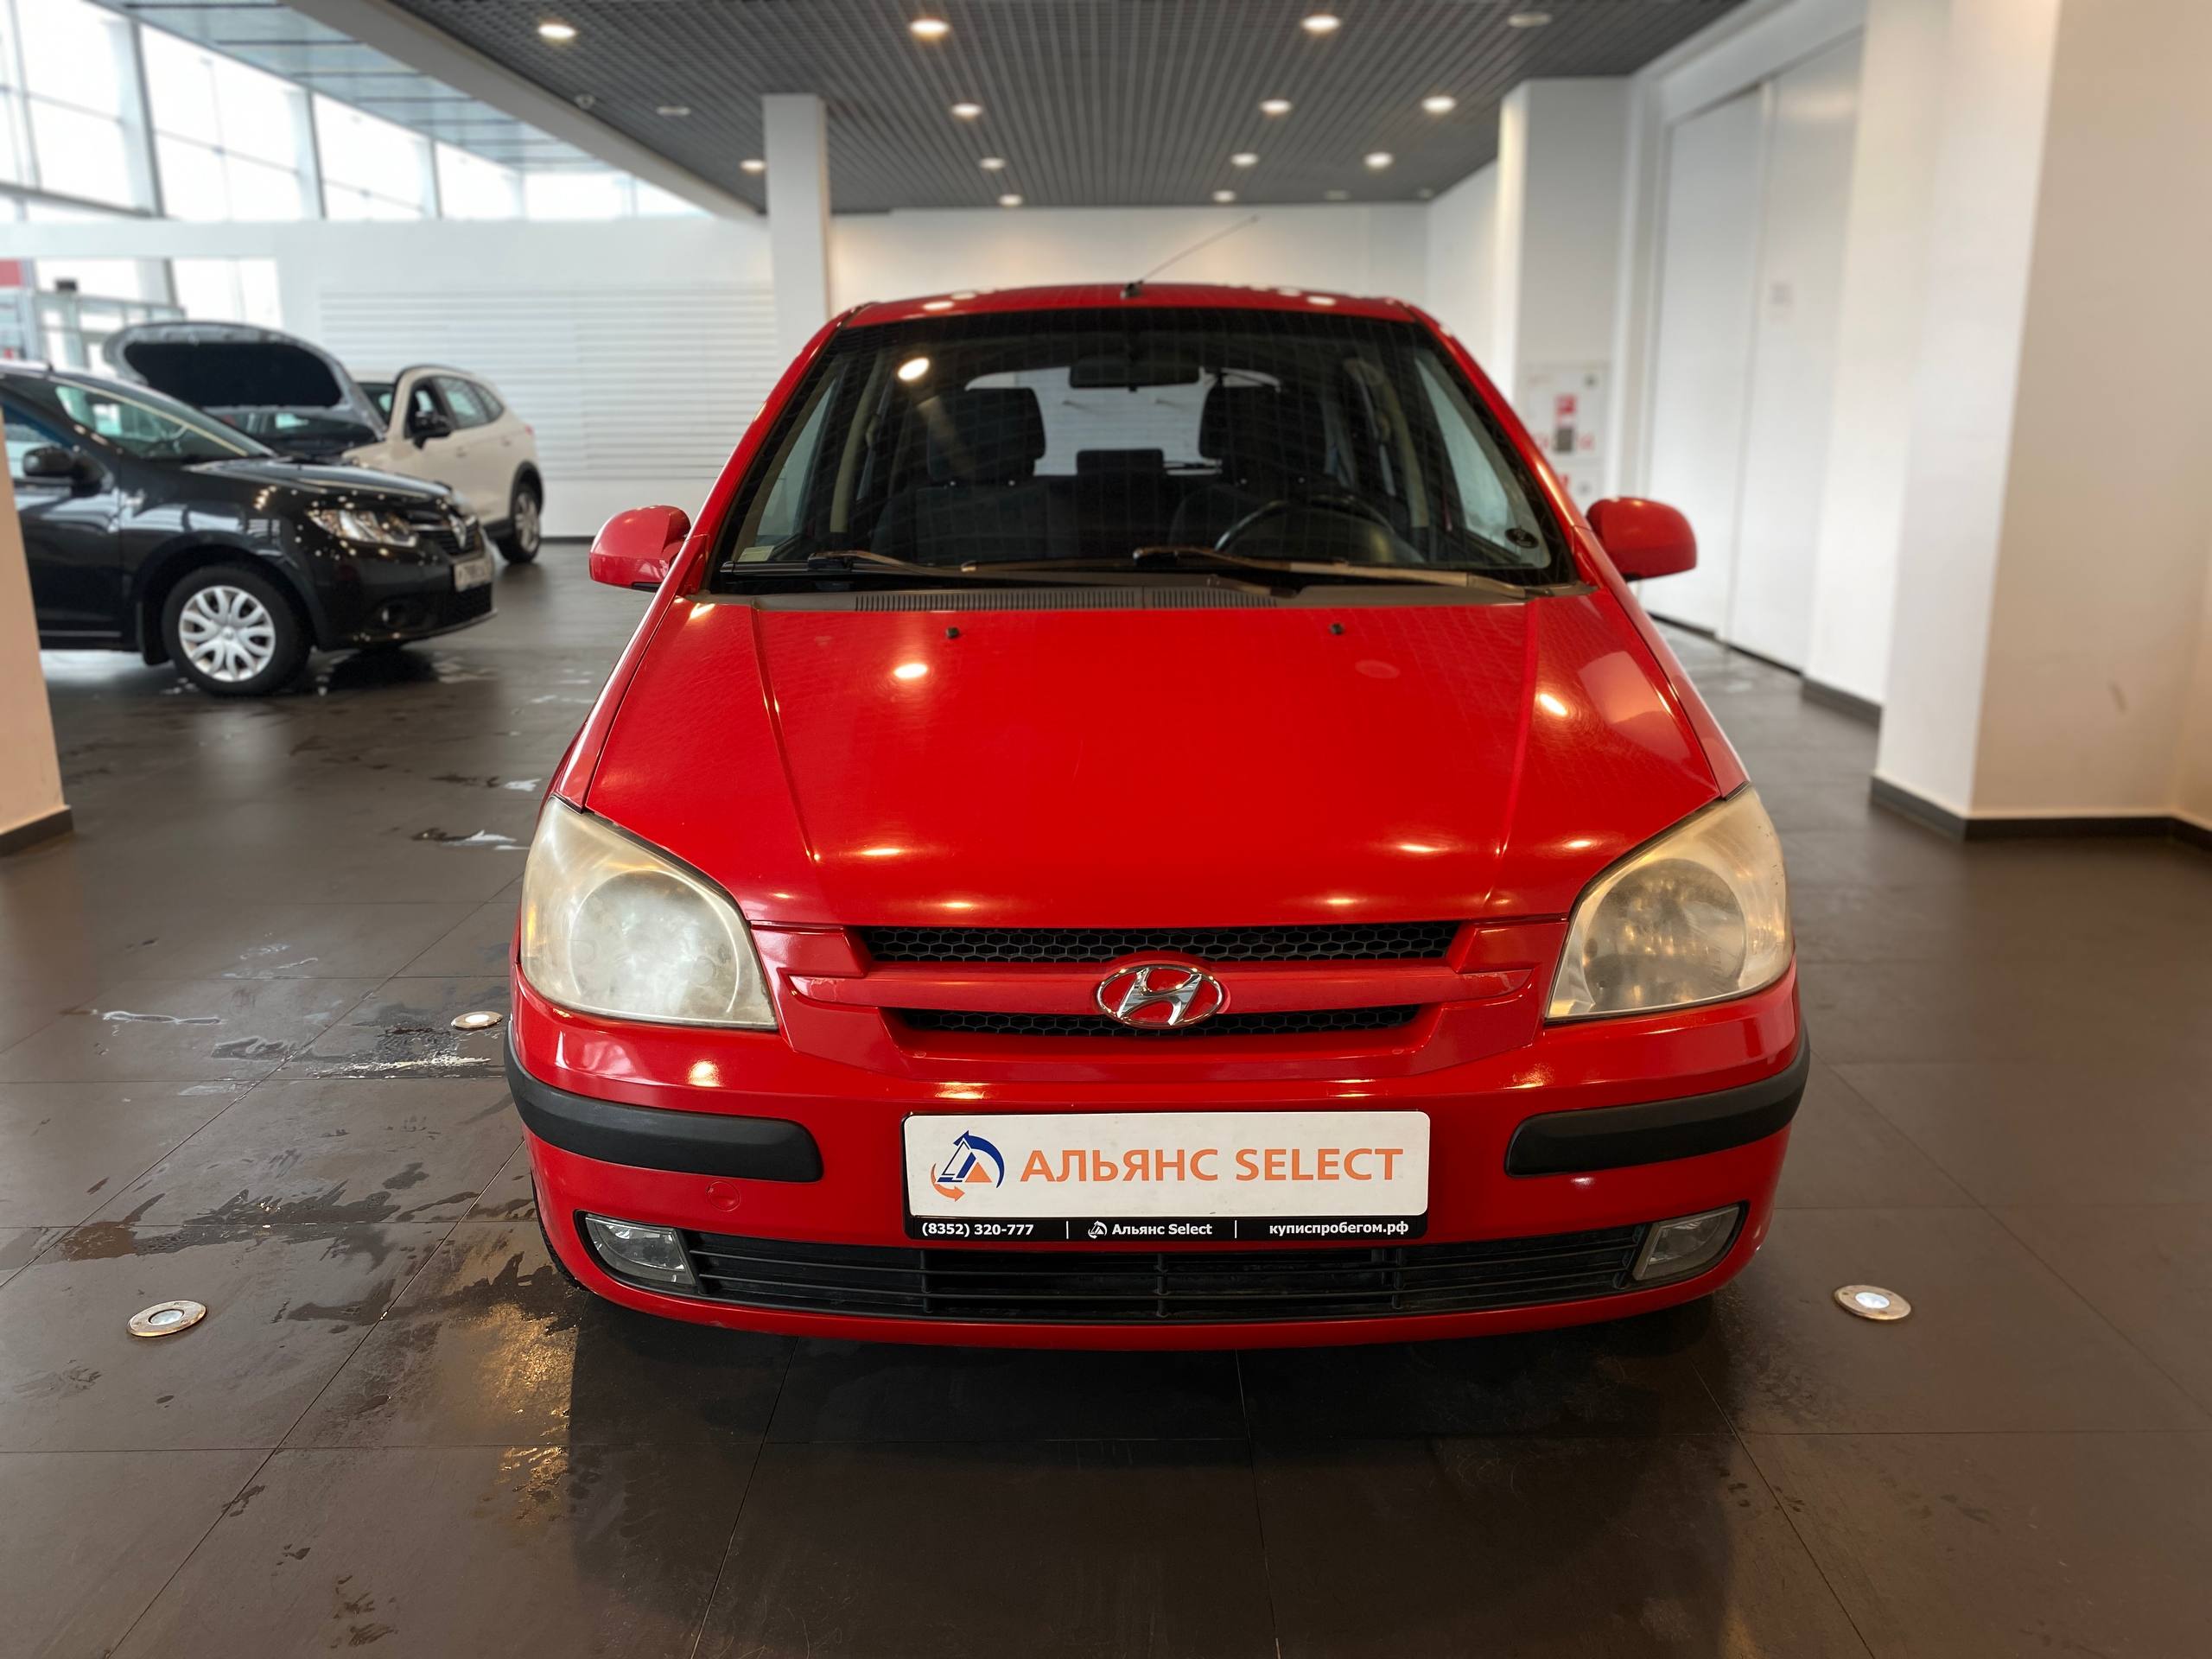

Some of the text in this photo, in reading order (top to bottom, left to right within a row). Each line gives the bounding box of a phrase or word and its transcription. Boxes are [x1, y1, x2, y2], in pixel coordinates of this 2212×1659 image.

[1020, 1147, 1404, 1183] АЛЬЯНС SELECT
[921, 1222, 1035, 1237] (8352) 320-777
[1111, 1222, 1213, 1236] Альянс Select
[1269, 1221, 1409, 1236] куписпробегом.рф
